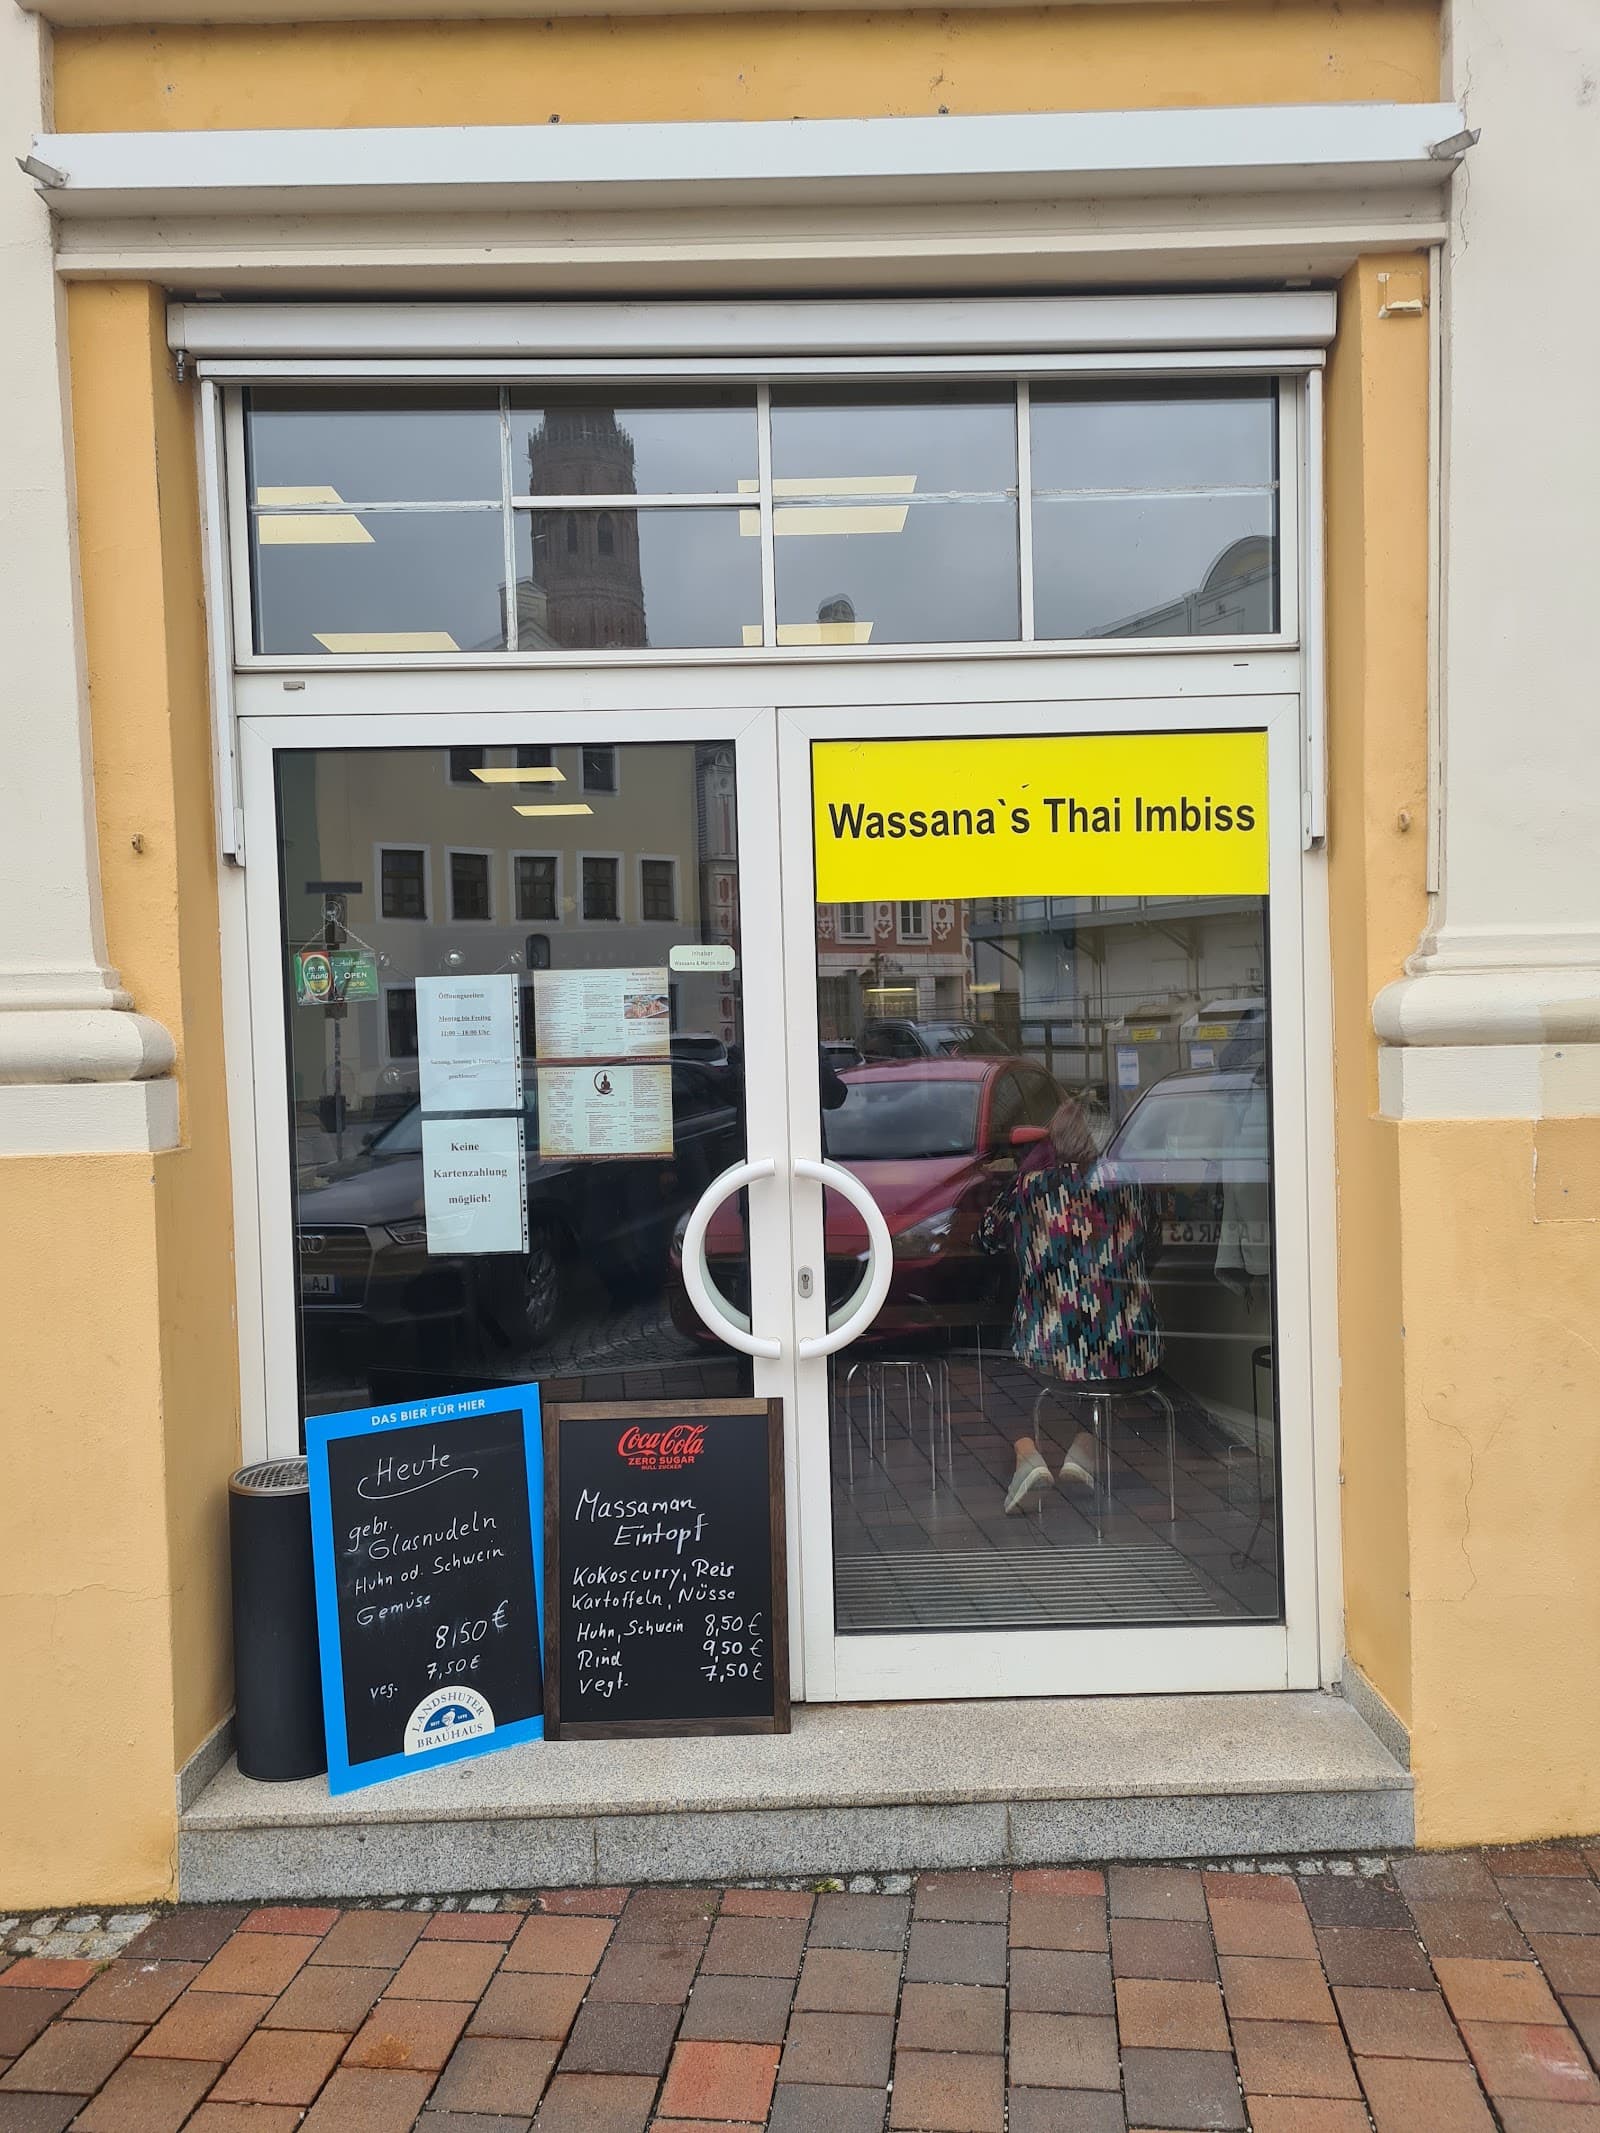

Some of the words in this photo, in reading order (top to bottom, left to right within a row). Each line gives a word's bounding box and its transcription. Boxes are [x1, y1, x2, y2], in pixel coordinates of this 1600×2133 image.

[1043, 797, 1122, 833] Thai
[1135, 795, 1256, 832] Imbiss
[451, 1142, 480, 1151] Keine
[433, 1168, 508, 1178] Kartenzahlung
[448, 1194, 492, 1205] möglich!
[371, 1413, 398, 1426] DAS
[400, 1408, 428, 1421] BIER
[431, 1403, 455, 1416] FÜR
[458, 1399, 486, 1412] HIER
[377, 1444, 451, 1486] Heute
[628, 1457, 657, 1466] ZERO
[659, 1455, 696, 1464] SUGAR
[575, 1488, 697, 1523] Massaman
[368, 1511, 497, 1560] Glasnudeln
[613, 1513, 709, 1555] Eintopf
[355, 1571, 393, 1596] Huhn
[400, 1564, 424, 1581] od.
[432, 1539, 504, 1574] Schwein
[691, 1558, 734, 1578] Reis
[678, 1583, 735, 1604] Nüsse
[623, 1618, 684, 1636] Schwein
[578, 1647, 623, 1671] Rind
[412, 1691, 485, 1733] LANDSHUTER
[417, 1723, 484, 1748] BRAUHAUS
